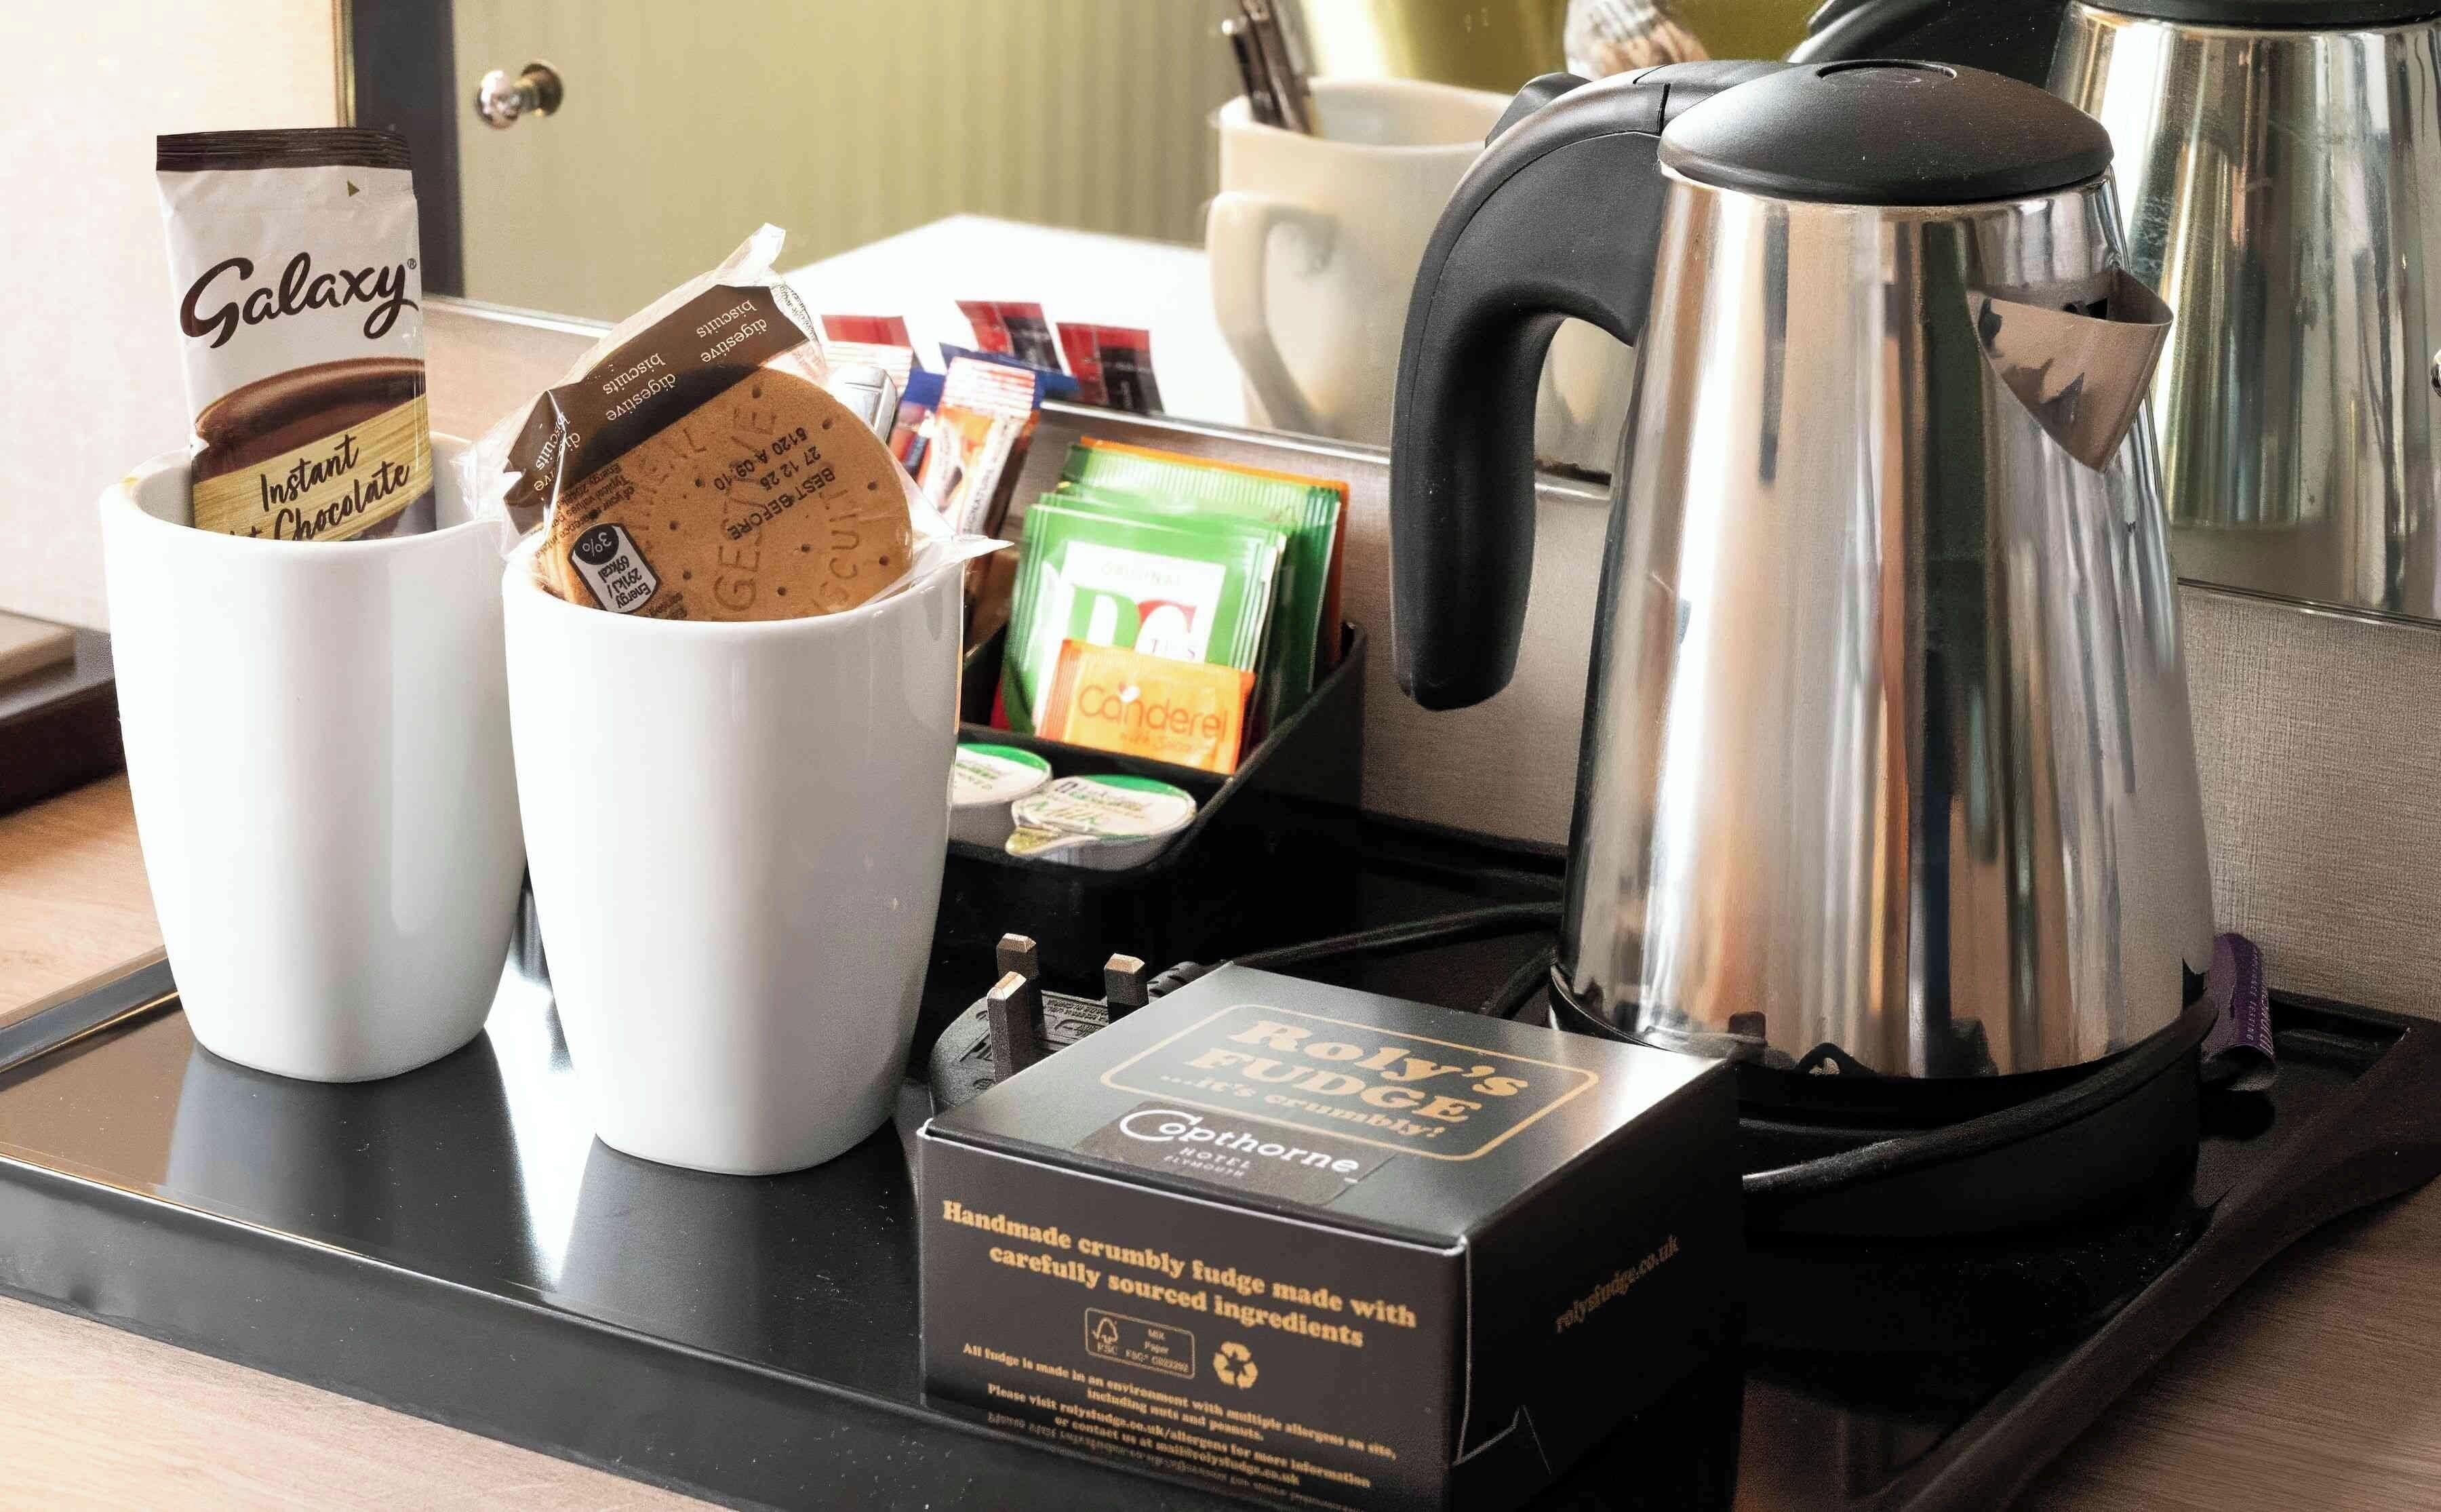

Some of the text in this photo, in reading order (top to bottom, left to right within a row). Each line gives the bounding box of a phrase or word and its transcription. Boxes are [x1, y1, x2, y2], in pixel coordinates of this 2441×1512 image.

[180, 252, 418, 349] Galaxy
[696, 298, 758, 340] biscuits
[700, 318, 768, 365] digestive
[601, 352, 667, 397] biscuits
[605, 372, 677, 422] digestive
[260, 434, 359, 512] Instant
[754, 448, 771, 466] A
[779, 458, 801, 479] 12
[800, 445, 822, 466] 27
[274, 460, 410, 540] Chocolate
[727, 466, 836, 542] BEST BEFORE
[580, 530, 614, 560] 3%
[596, 553, 632, 583] 69kcal
[613, 580, 652, 611] Energy
[1079, 683, 1229, 742] Canderel
[1227, 1020, 1530, 1096] Roly's
[1184, 1048, 1485, 1123] FUDGE
[1263, 1092, 1447, 1140] crumbly!
[1119, 1109, 1360, 1174] Copthorne
[1179, 1147, 1251, 1169] HOTEL
[942, 1199, 1418, 1328] Handmade crumbly fudge made with
[989, 1246, 1365, 1348] carefully sourced ingredients
[963, 1342, 982, 1357] All
[985, 1347, 1019, 1367] fudge
[1023, 1357, 1034, 1370] is
[1035, 1362, 1069, 1378] made
[1071, 1369, 1086, 1383] in
[1088, 1375, 1104, 1388] an
[1107, 1378, 1189, 1408] environment
[1192, 1399, 1223, 1416] with
[1227, 1408, 1282, 1431] multiple
[1284, 1423, 1345, 1446] allergens
[1347, 1438, 1364, 1452] on
[1088, 1388, 1147, 1414] including
[1150, 1405, 1179, 1421] nuts
[1182, 1412, 1206, 1427] and
[987, 1382, 1026, 1403] Please
[1029, 1393, 1057, 1411] visit
[1230, 1443, 1251, 1458] for
[1254, 1451, 1288, 1467] more
[1290, 1458, 1372, 1488] information
[1055, 1415, 1069, 1427] or
[1072, 1419, 1117, 1441] contact
[1121, 1432, 1136, 1444] us
[1138, 1436, 1153, 1448] at
